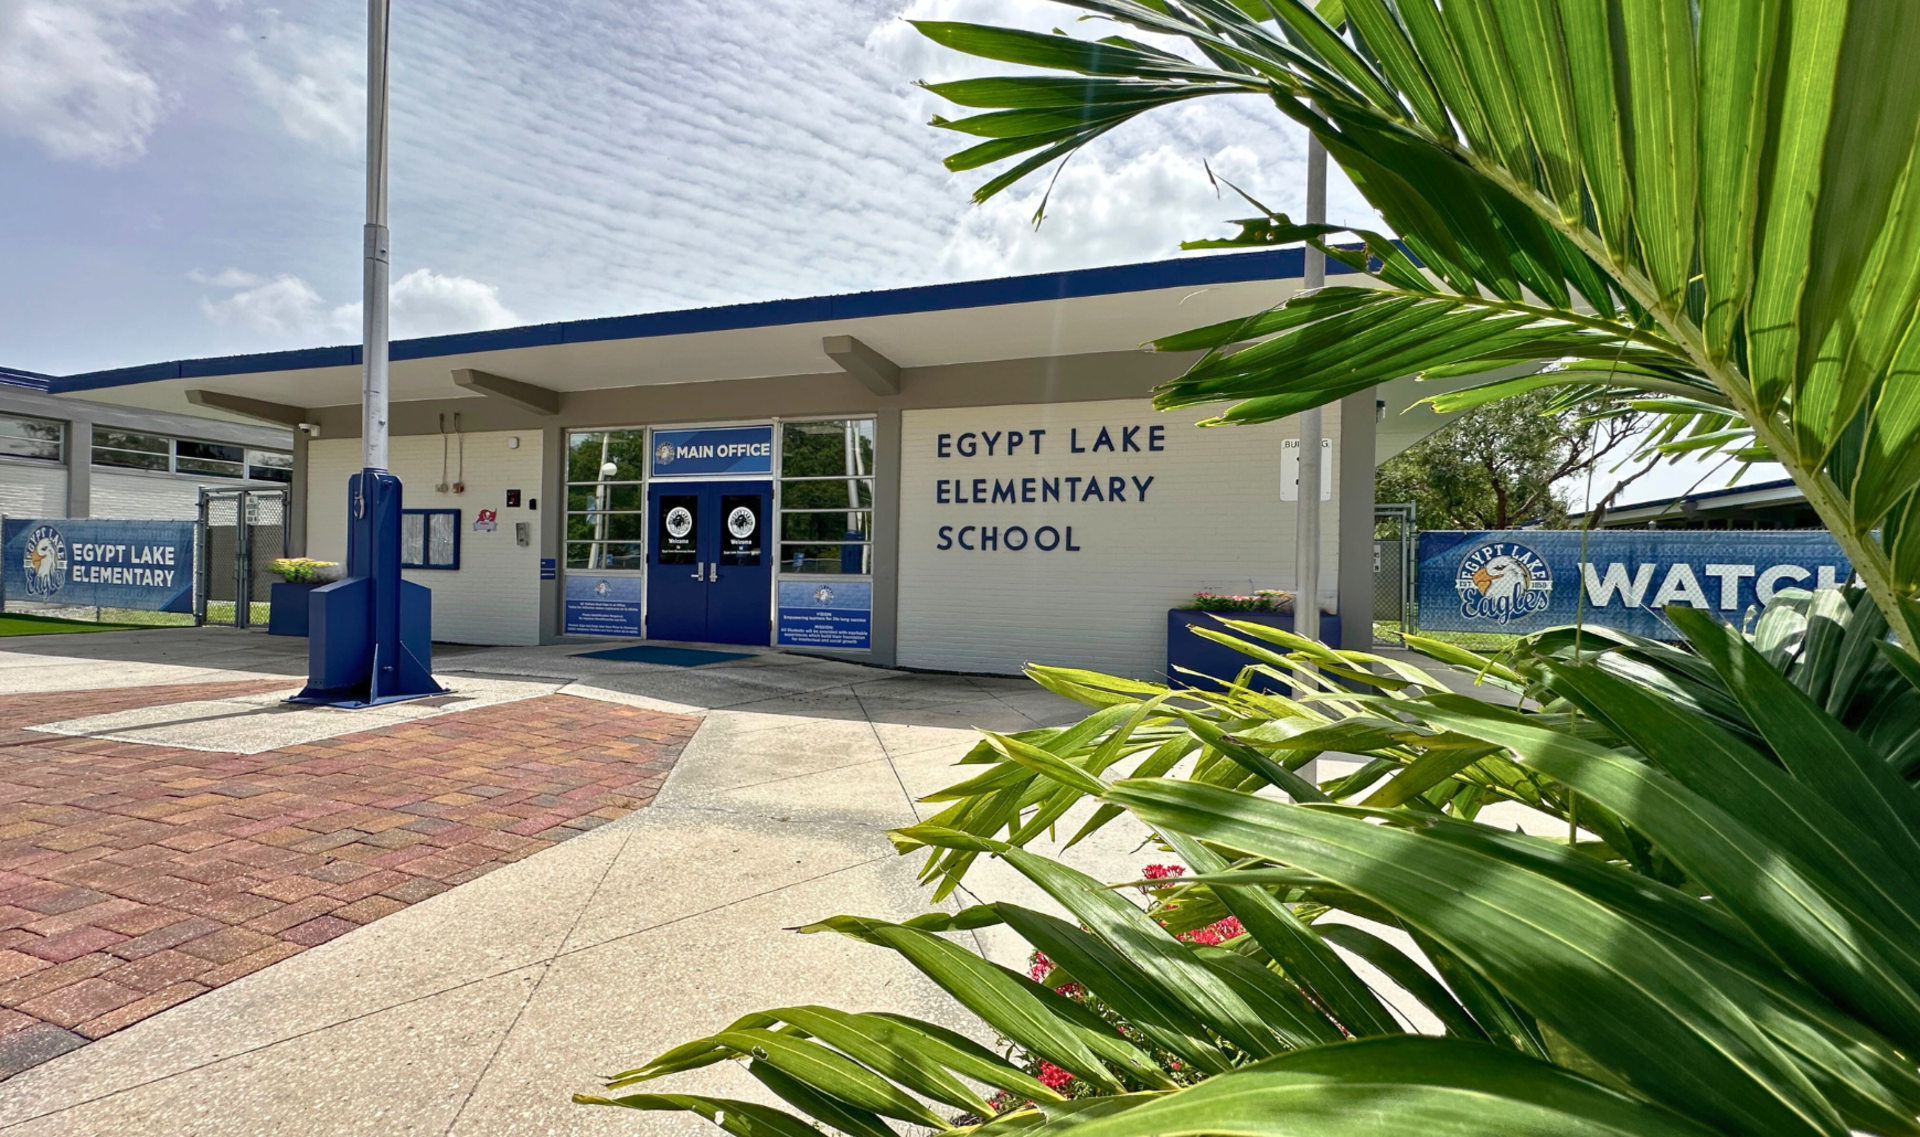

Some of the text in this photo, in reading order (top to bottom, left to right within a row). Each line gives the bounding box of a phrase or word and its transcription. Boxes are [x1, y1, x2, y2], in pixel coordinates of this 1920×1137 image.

[676, 445, 714, 459] MAIN
[717, 443, 770, 458] OFFICE
[937, 425, 1165, 458] EGYPT LAKE
[1284, 440, 1328, 448] BUIG
[936, 475, 1154, 504] ELEMENTARY
[936, 526, 1080, 552] SCHOOL
[72, 543, 174, 565] EGYPT LAKE
[1462, 544, 1546, 580] EGYPT LAKE
[72, 566, 174, 588] ELEMENTARY
[1461, 582, 1549, 625] Eagles
